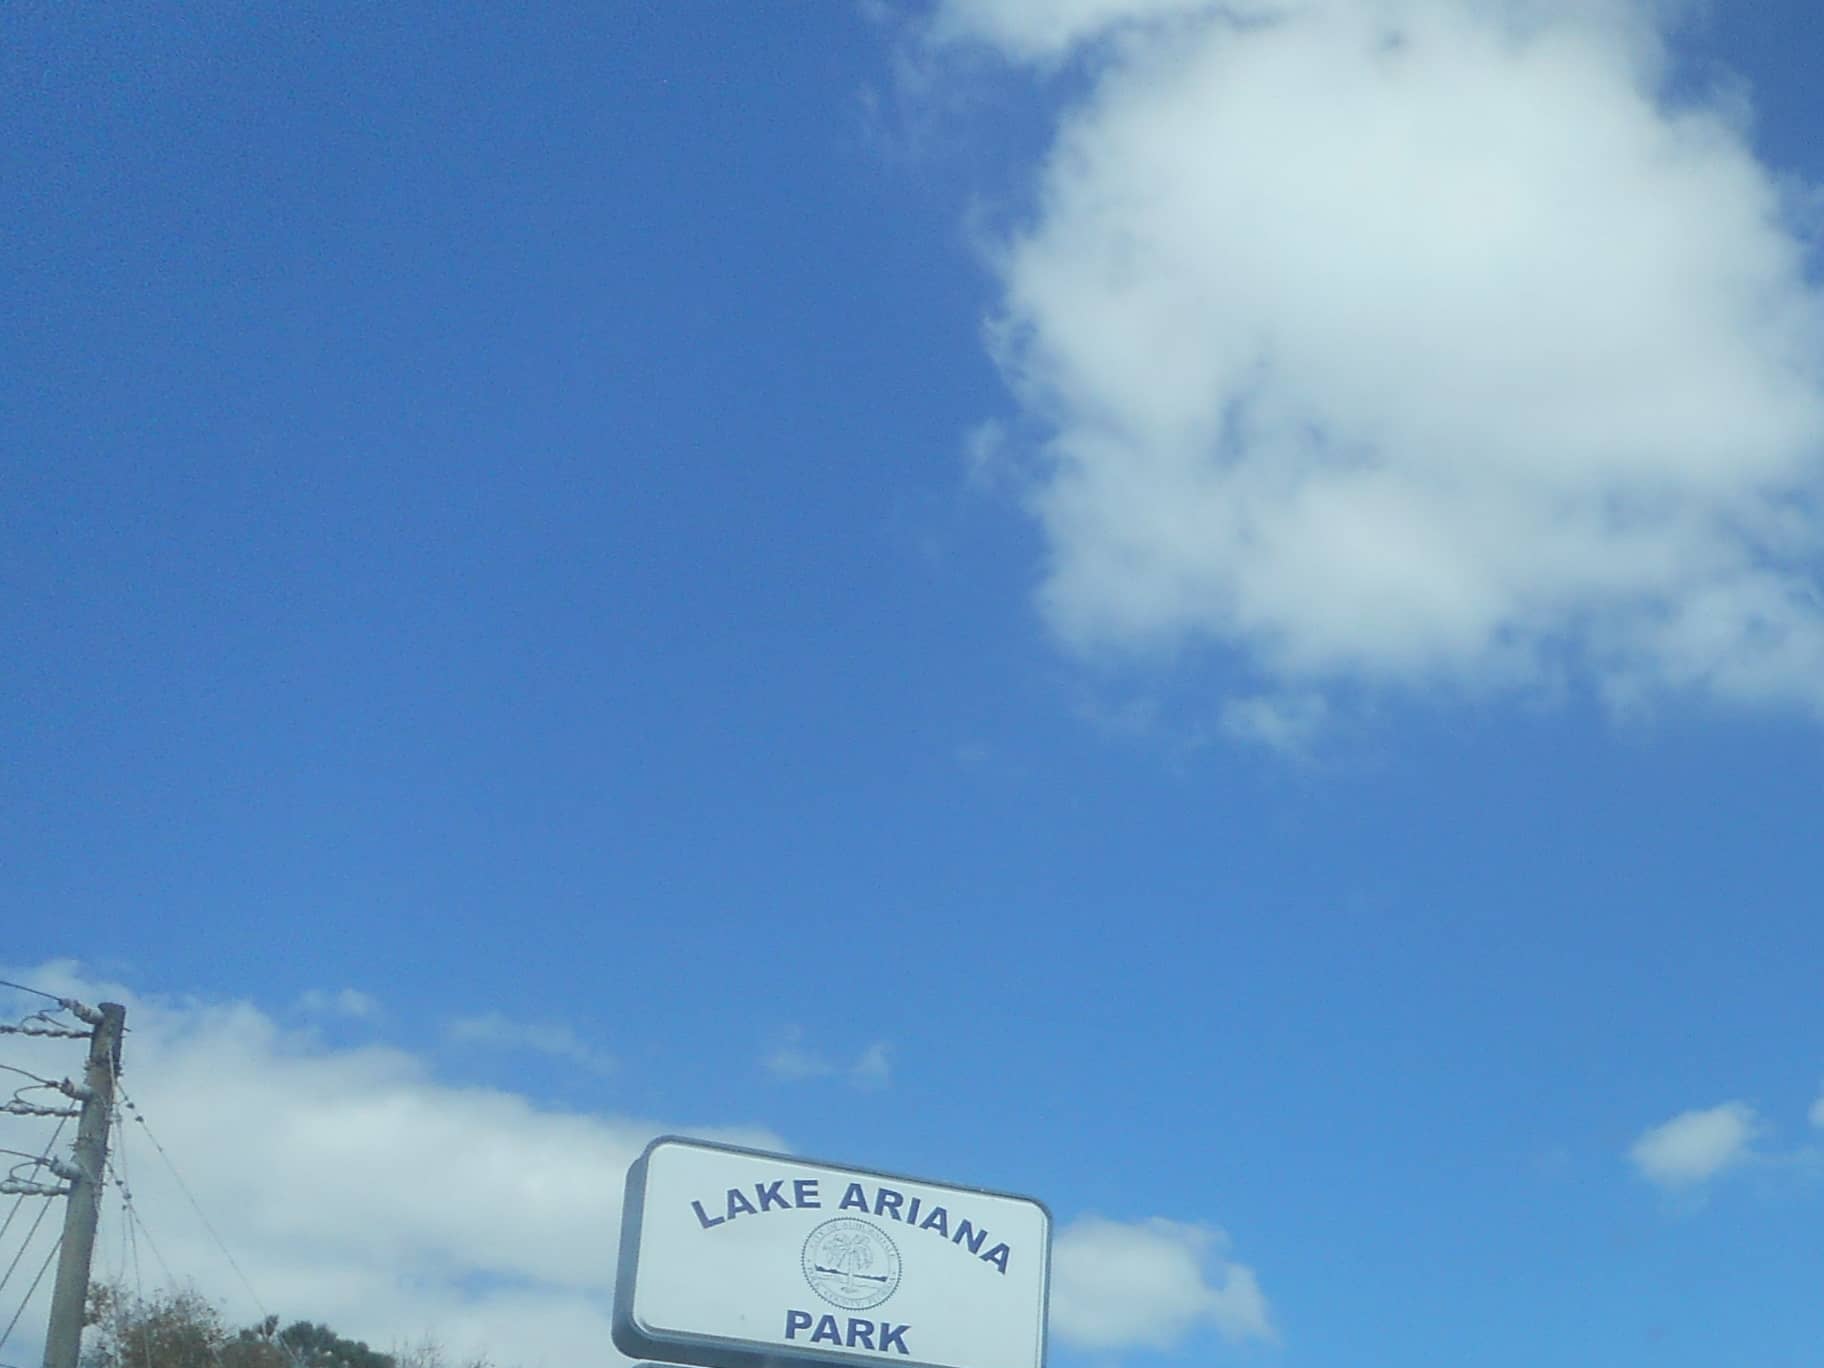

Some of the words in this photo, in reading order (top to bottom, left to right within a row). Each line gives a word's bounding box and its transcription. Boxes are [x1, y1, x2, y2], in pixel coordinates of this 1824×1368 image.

[691, 1179, 822, 1229] LAKE
[839, 1183, 1010, 1275] ARIANA
[784, 1309, 912, 1355] PARK
